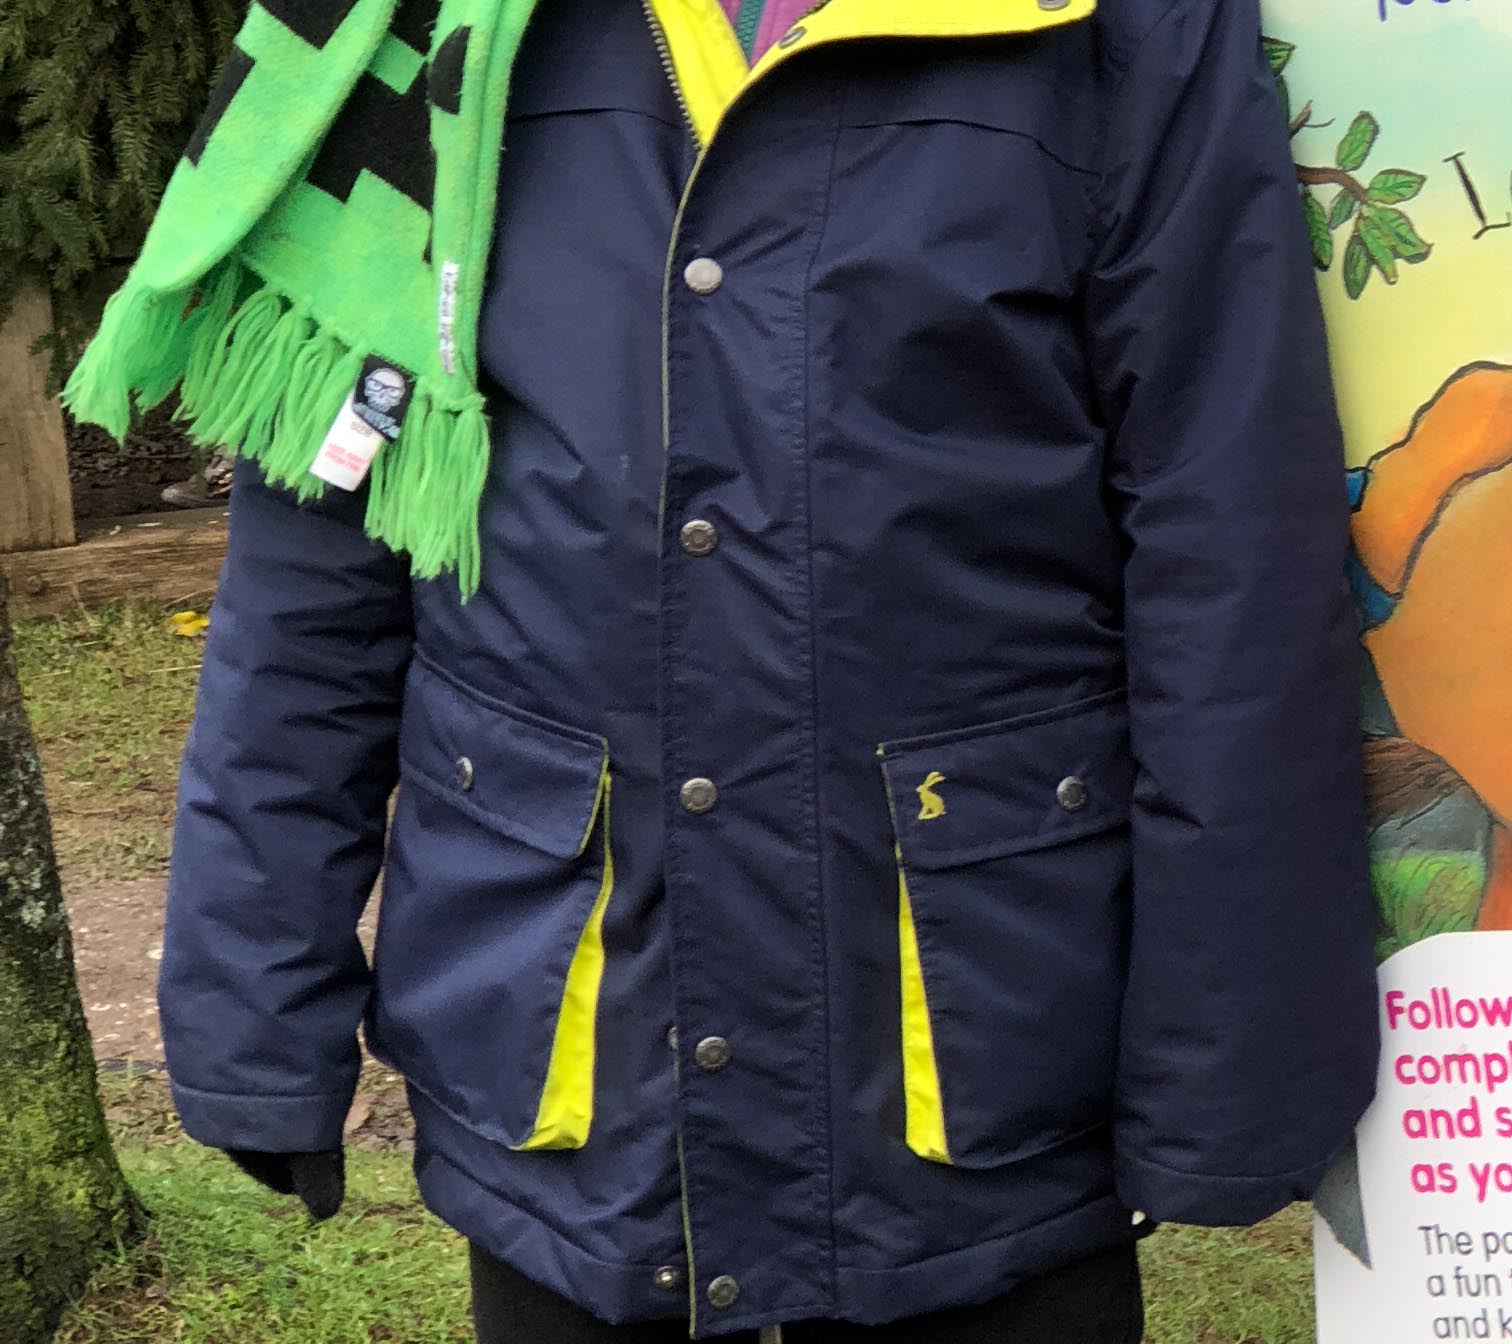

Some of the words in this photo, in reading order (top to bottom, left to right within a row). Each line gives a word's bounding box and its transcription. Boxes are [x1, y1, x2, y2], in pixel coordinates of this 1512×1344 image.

[1402, 1095, 1483, 1141] and
[1410, 1159, 1457, 1196] as
[1418, 1223, 1473, 1257] The
[1427, 1274, 1446, 1298] a
[1453, 1266, 1502, 1298] fun
[1433, 1308, 1491, 1340] and
